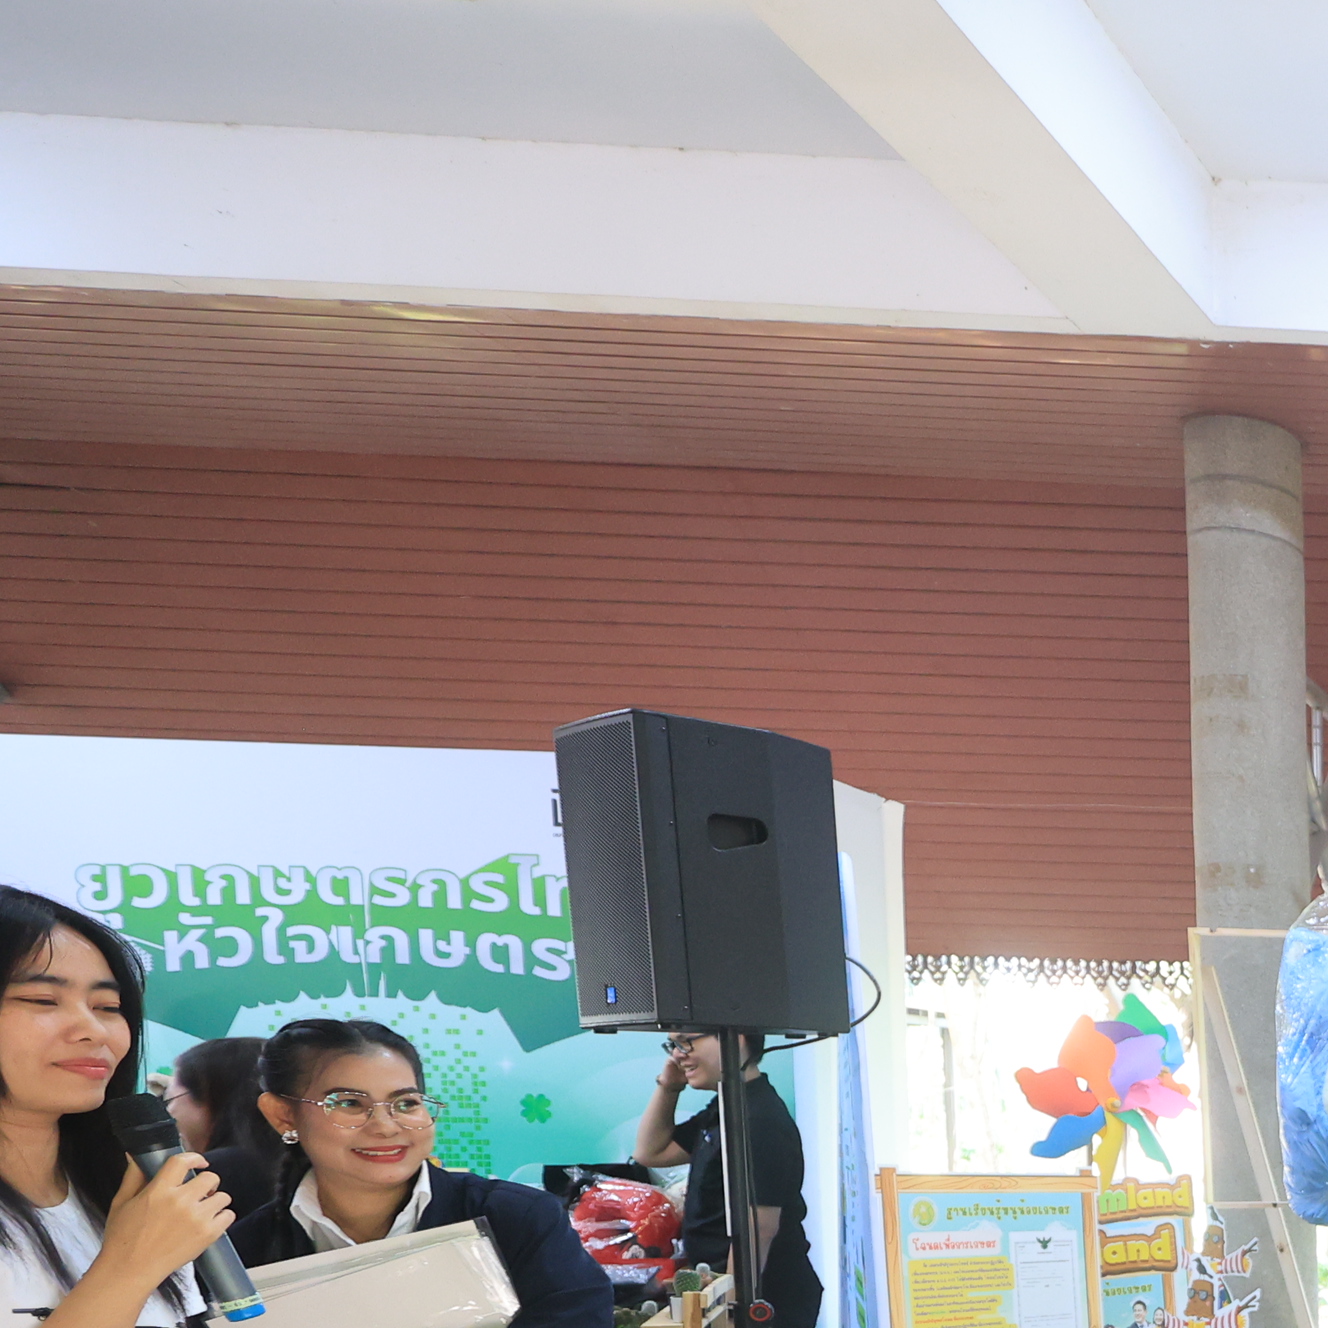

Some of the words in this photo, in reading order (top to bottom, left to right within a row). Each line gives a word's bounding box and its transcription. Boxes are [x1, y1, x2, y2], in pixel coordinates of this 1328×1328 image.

[162, 906, 573, 982] หัวใจเกษตร
[1102, 1229, 1172, 1264] and
